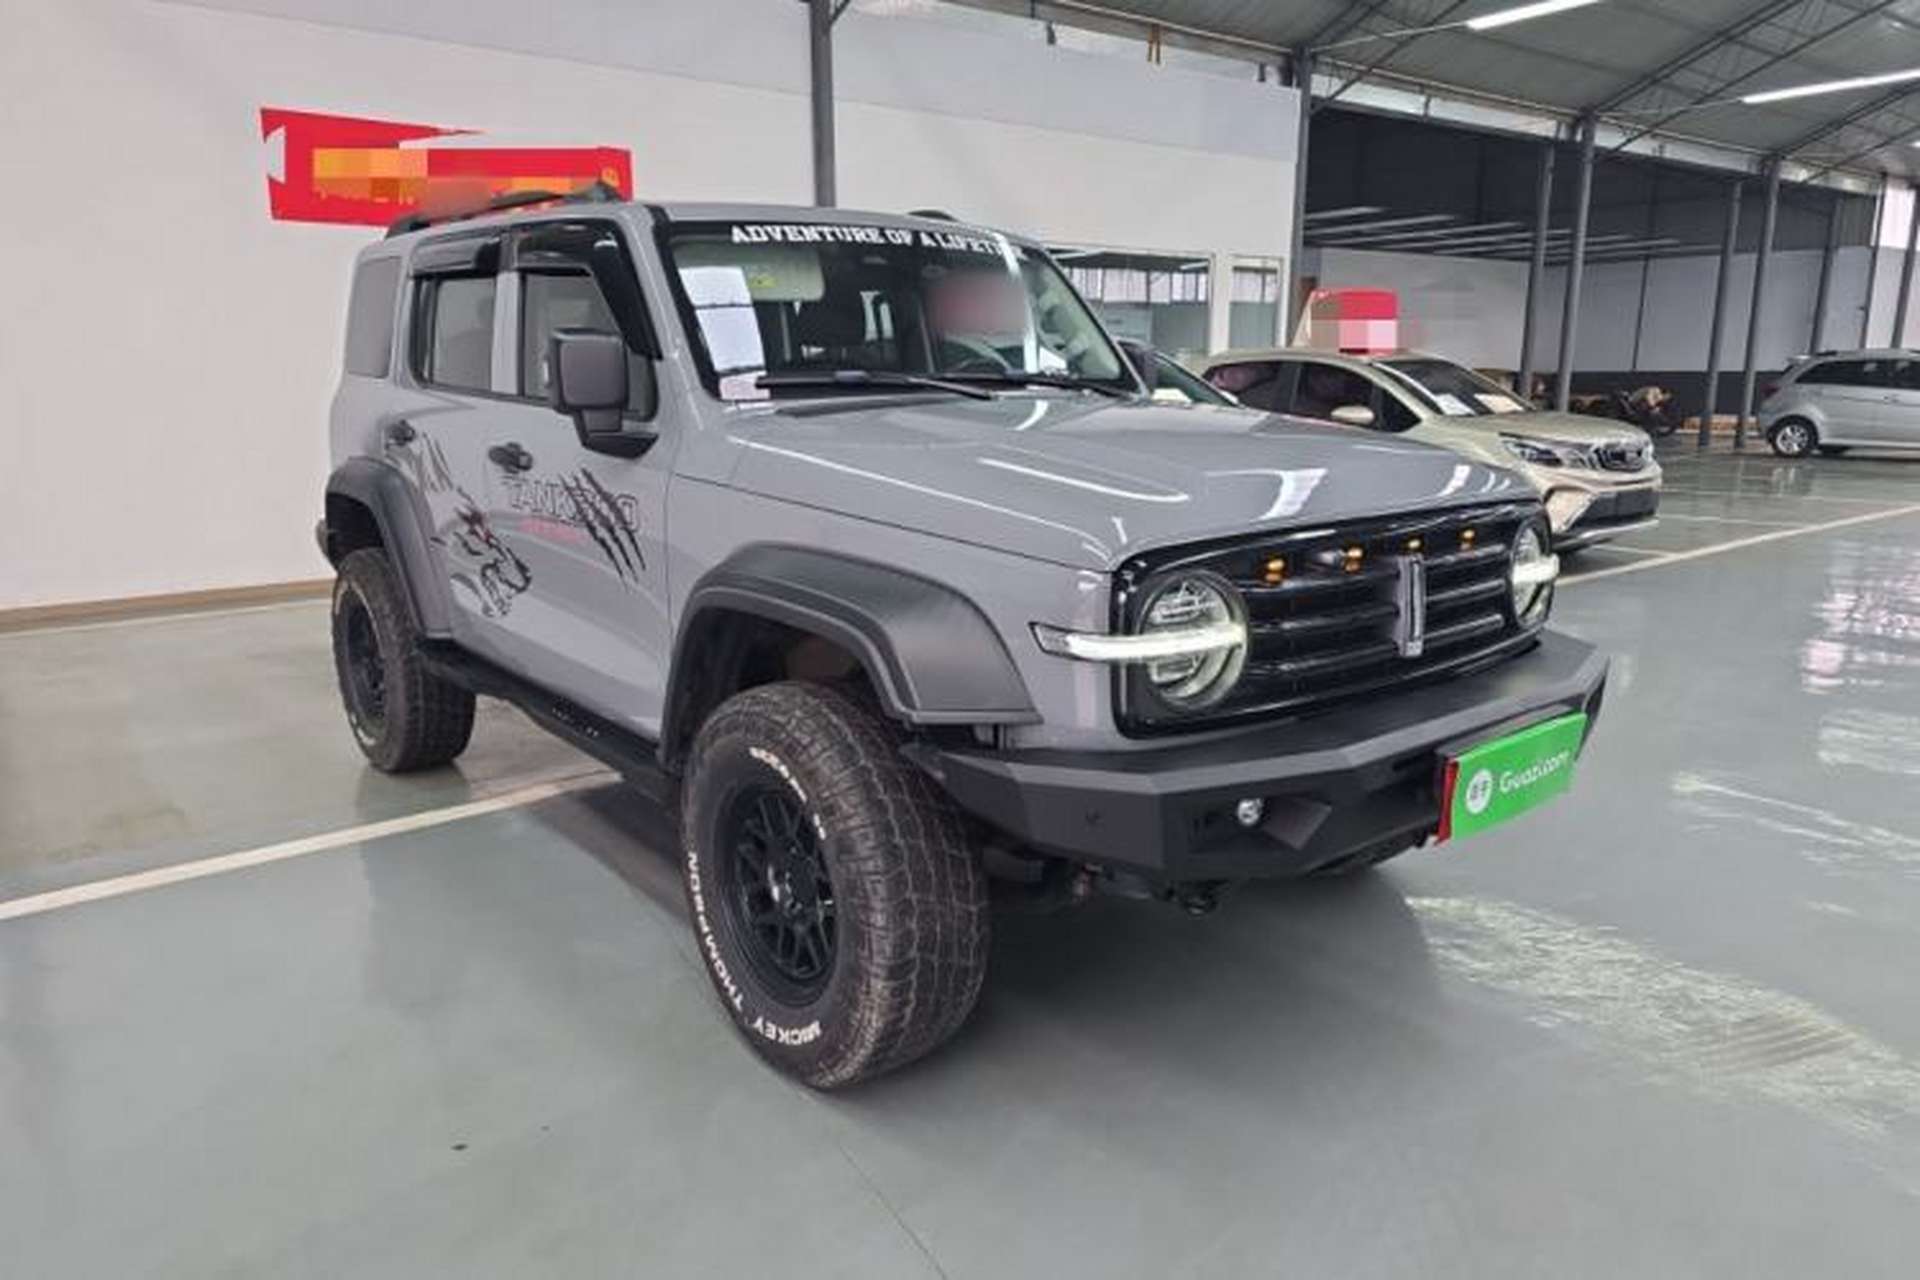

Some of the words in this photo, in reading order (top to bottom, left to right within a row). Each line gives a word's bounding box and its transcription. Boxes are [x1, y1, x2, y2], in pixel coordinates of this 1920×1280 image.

[731, 224, 885, 244] ADVENTURE
[883, 228, 912, 246] OF
[920, 230, 938, 247] A
[687, 850, 744, 1012] THOMPSON
[753, 1015, 822, 1046] MICKEY
